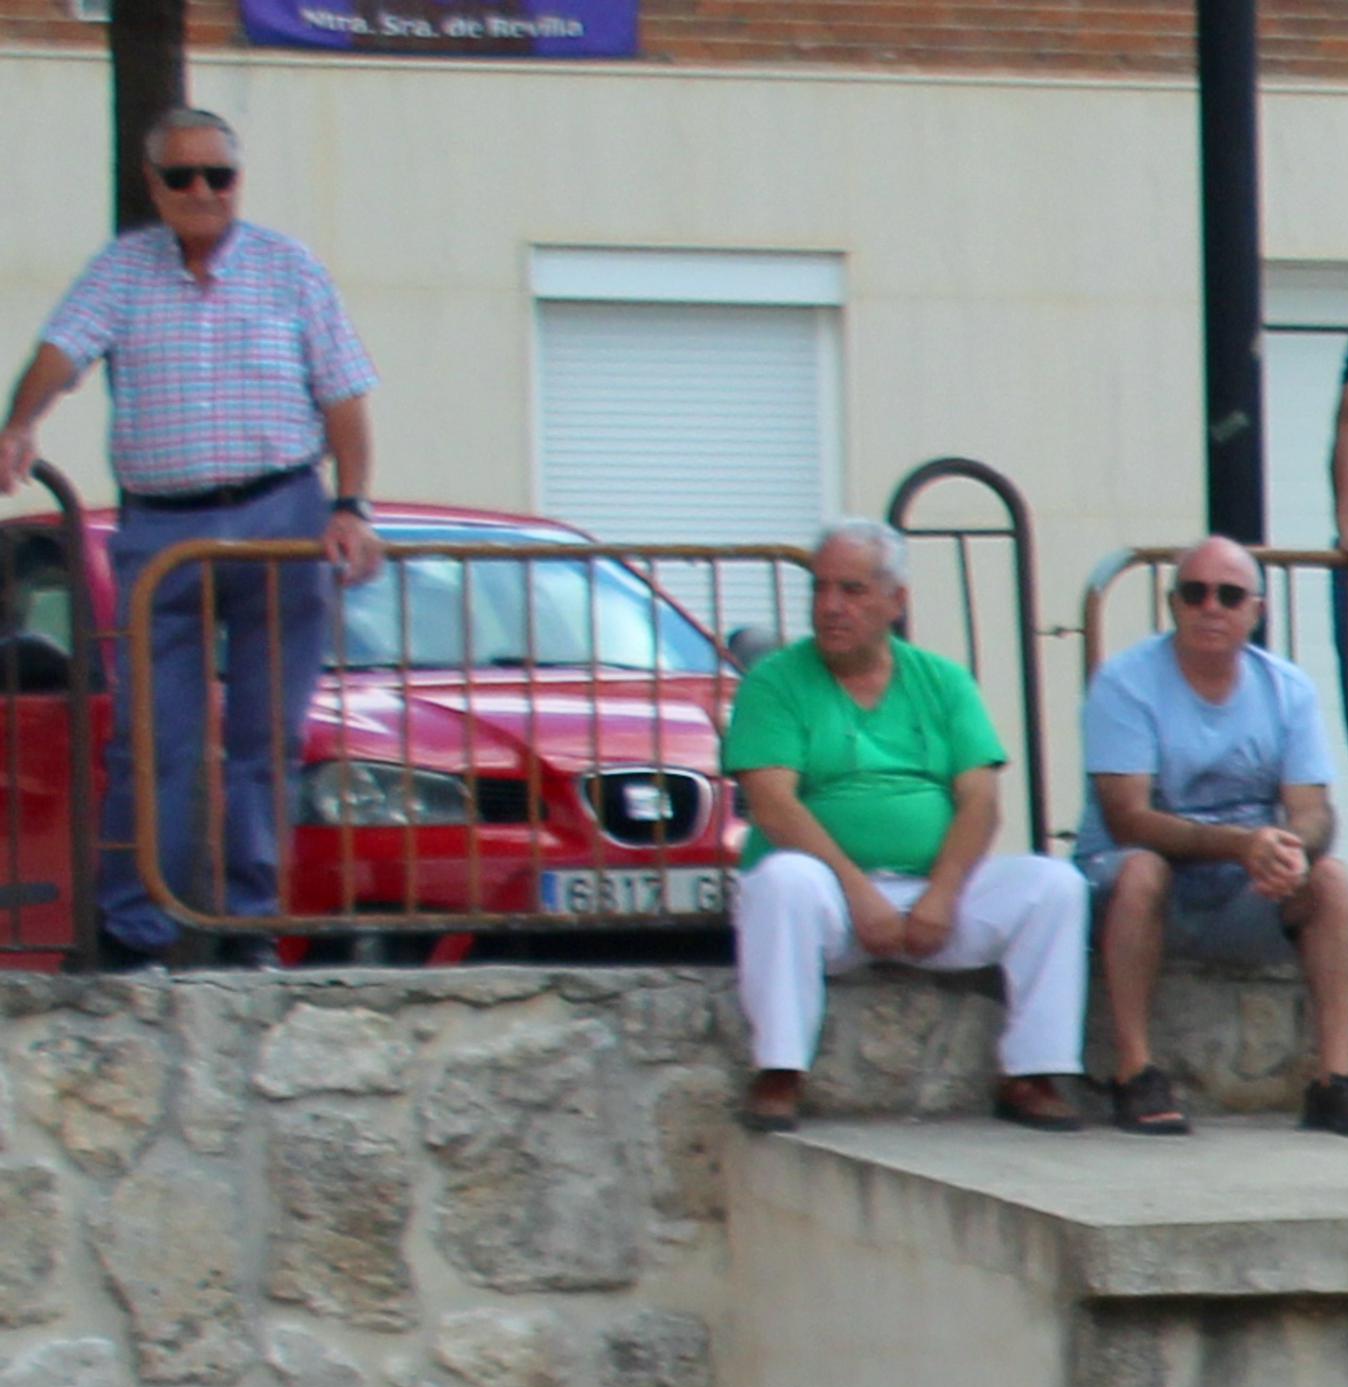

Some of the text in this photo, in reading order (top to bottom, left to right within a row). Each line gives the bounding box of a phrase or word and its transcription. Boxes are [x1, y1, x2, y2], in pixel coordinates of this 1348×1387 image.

[380, 13, 440, 38] Sra.
[444, 16, 483, 39] de
[486, 15, 584, 39] Revilla
